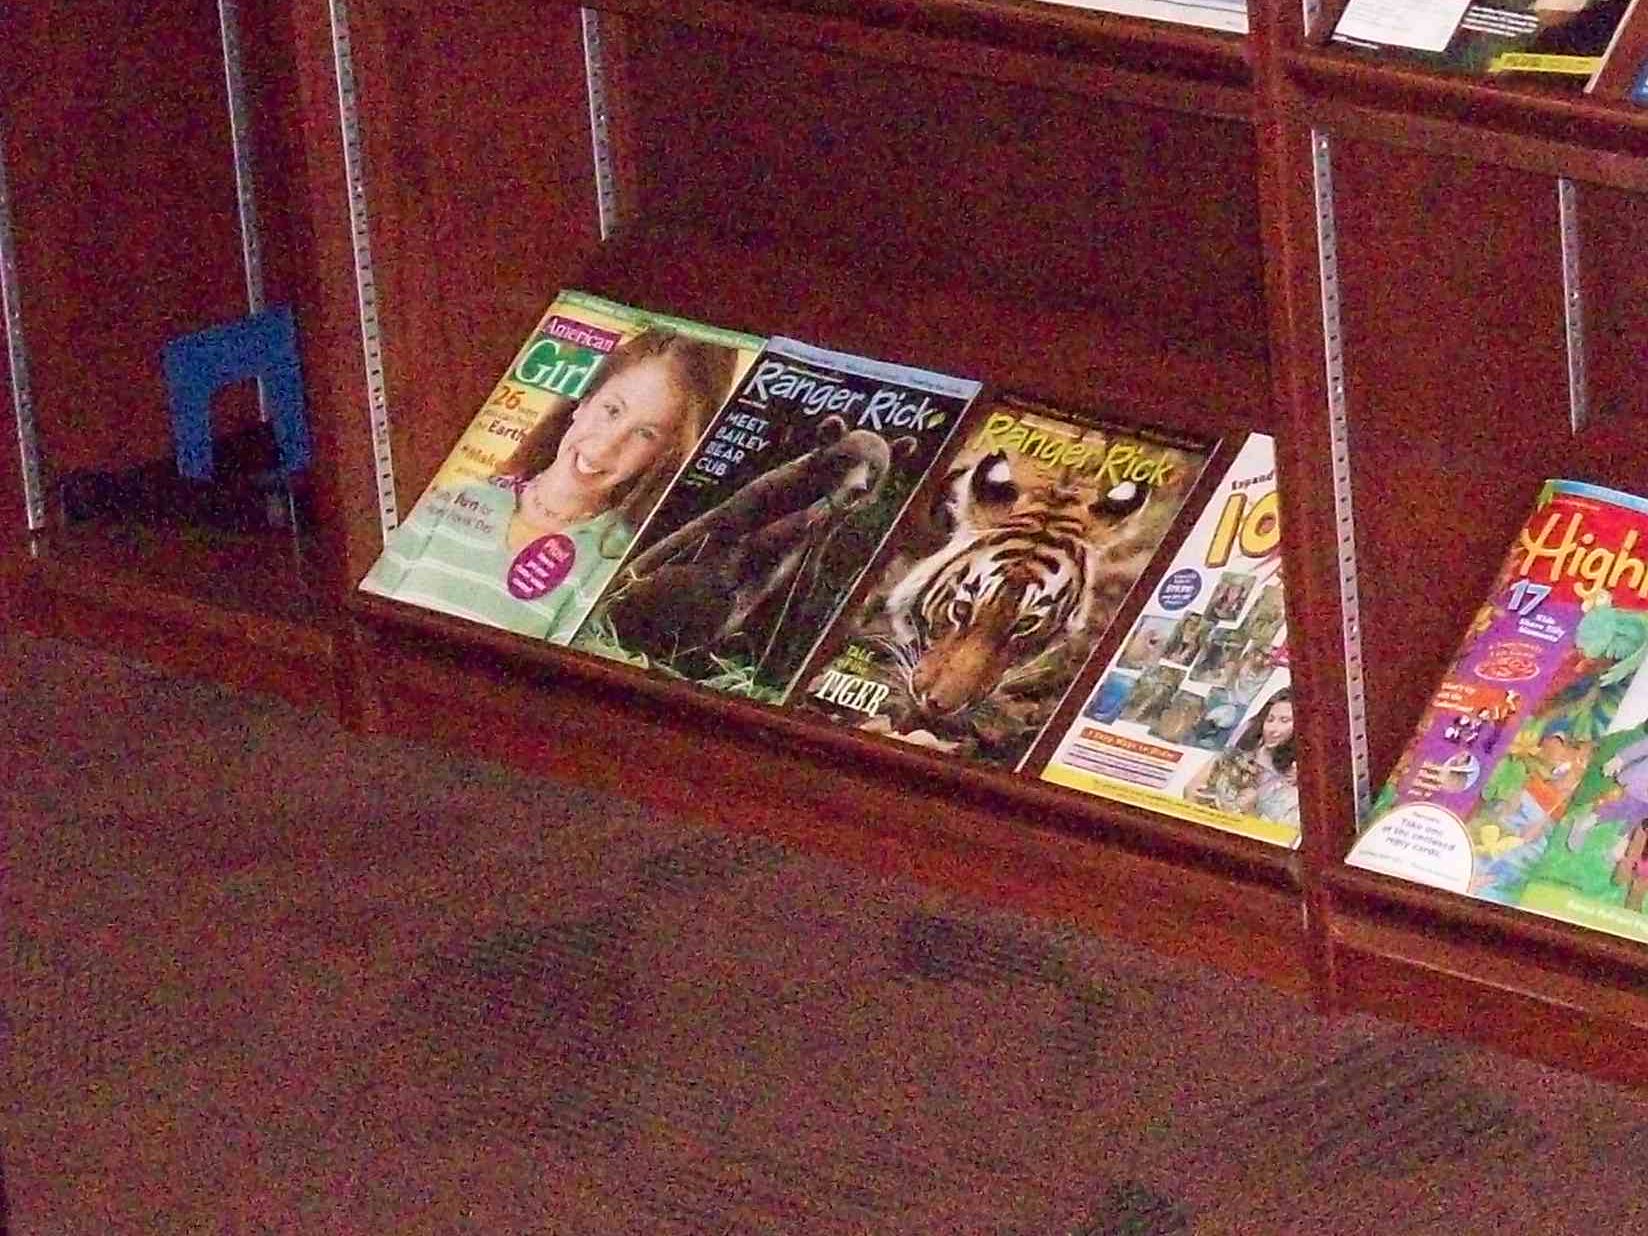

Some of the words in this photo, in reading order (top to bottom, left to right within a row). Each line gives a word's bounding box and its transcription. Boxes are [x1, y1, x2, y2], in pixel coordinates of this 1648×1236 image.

[549, 317, 614, 353] American
[514, 338, 605, 400] Girl
[744, 359, 867, 421] Ranger
[859, 388, 937, 434] Rick
[715, 425, 771, 452] BAILEY
[726, 412, 769, 432] MEET
[695, 457, 728, 477] CUB
[705, 439, 745, 464] BEAR
[973, 411, 1102, 467] Ranger
[1096, 442, 1174, 488] Rick
[1507, 578, 1552, 616] 17
[815, 669, 890, 718] TIGER
